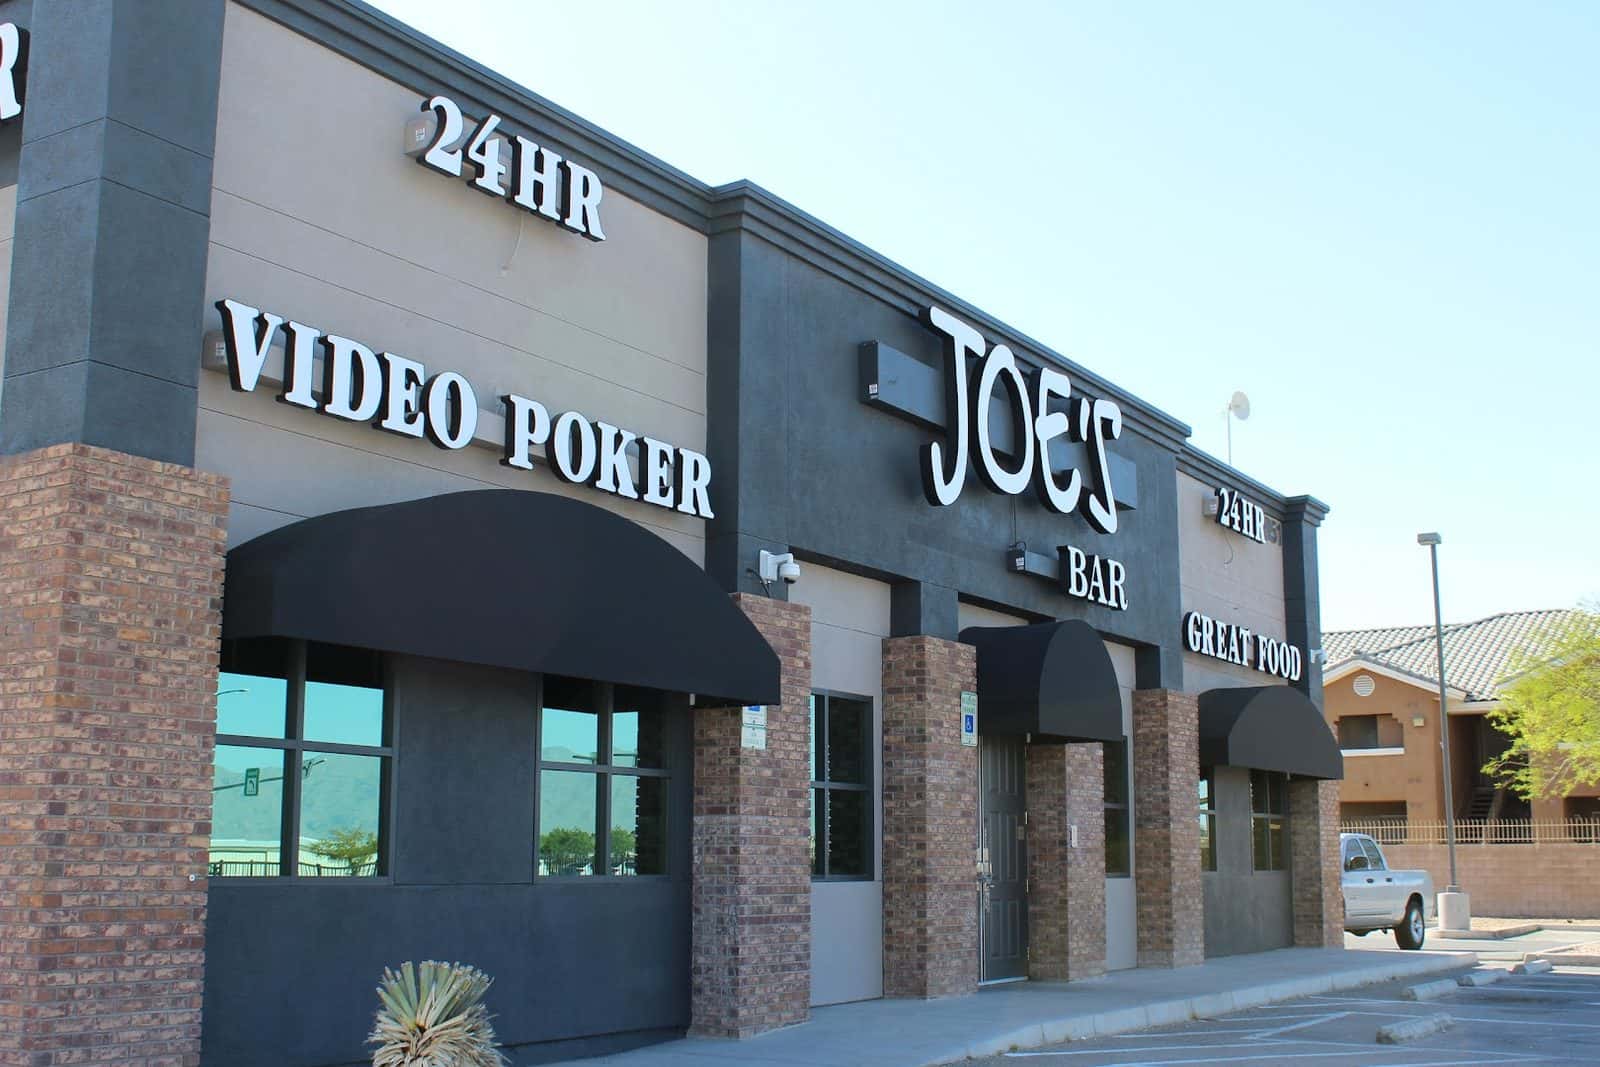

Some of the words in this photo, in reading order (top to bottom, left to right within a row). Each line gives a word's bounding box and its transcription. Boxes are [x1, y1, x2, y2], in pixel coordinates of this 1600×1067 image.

[423, 96, 606, 242] 24HR
[222, 298, 478, 450] VIDEO
[507, 394, 714, 520] POKER
[930, 305, 1122, 534] JOE'S
[1218, 486, 1266, 544] 24HR
[1066, 545, 1128, 611] BAR
[1187, 611, 1252, 667] GREAT
[1258, 635, 1302, 682] FOOD
